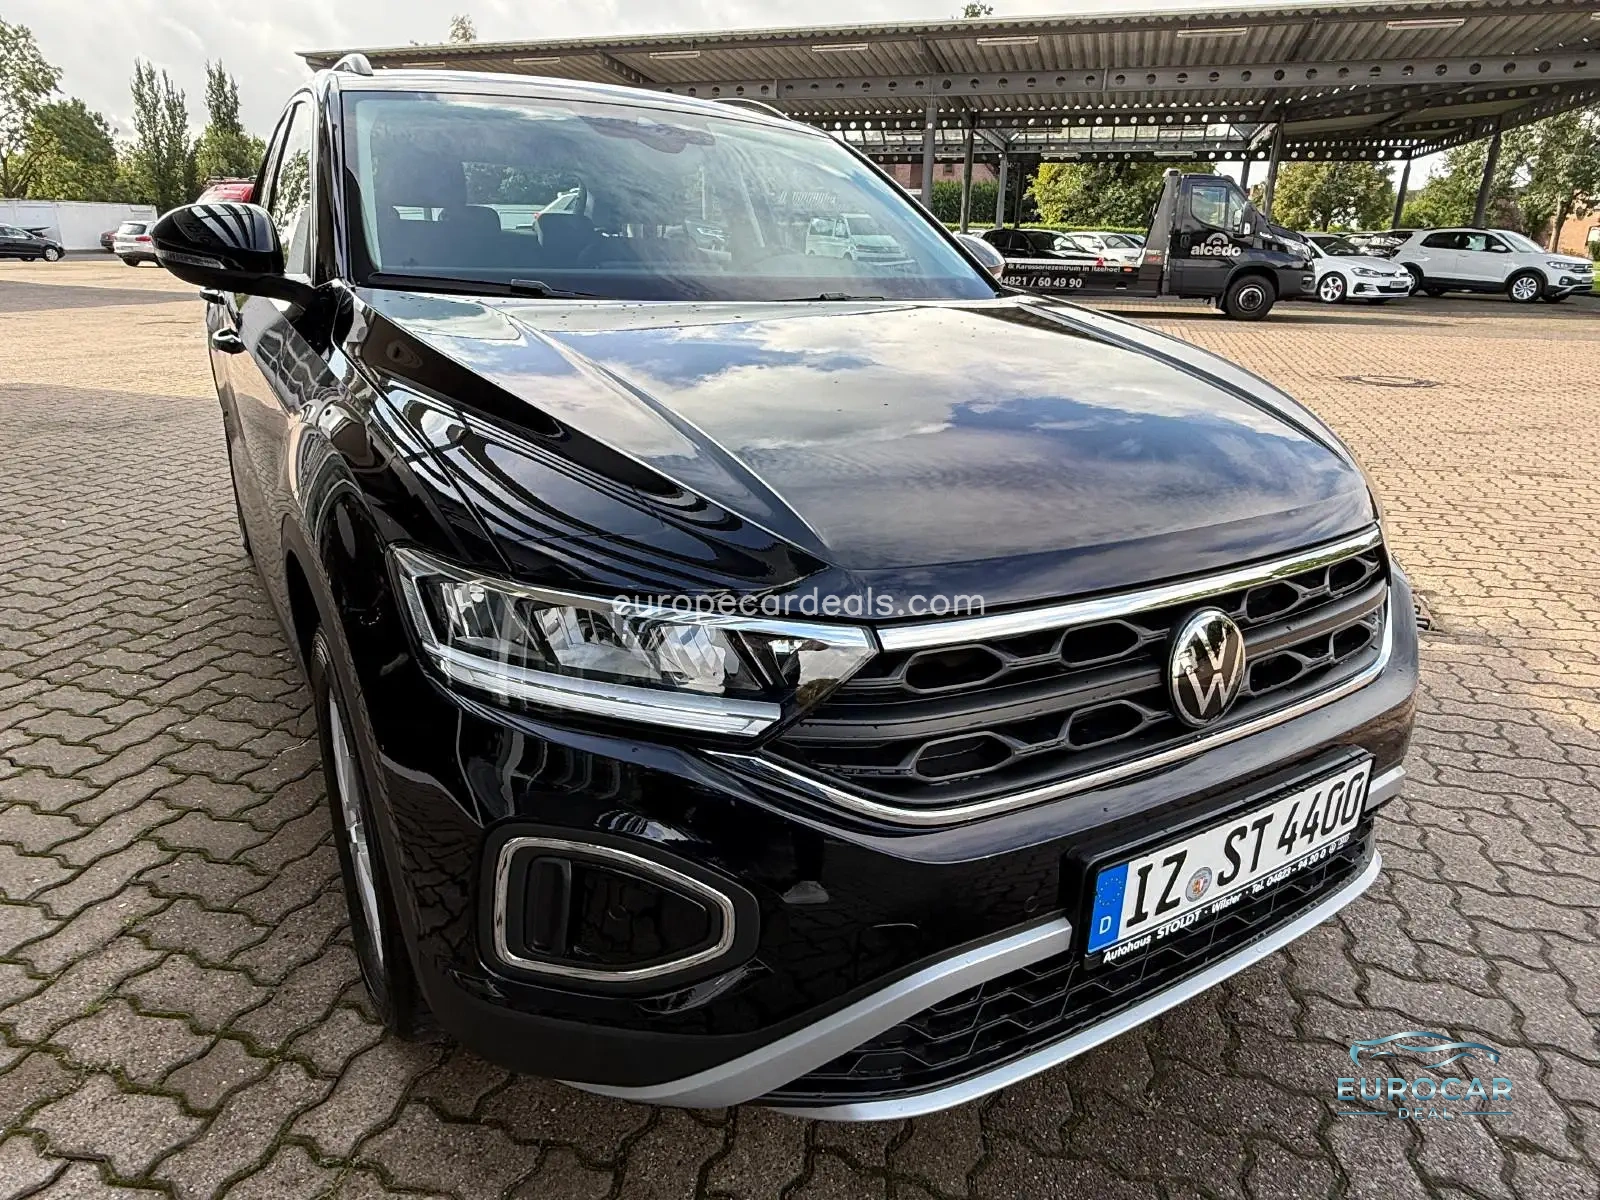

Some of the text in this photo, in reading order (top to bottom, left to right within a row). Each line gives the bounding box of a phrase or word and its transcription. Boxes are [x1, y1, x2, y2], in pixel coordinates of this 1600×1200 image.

[1190, 242, 1242, 257] alcedo
[1038, 277, 1051, 287] 60
[1053, 278, 1067, 287] 49
[1069, 278, 1082, 288] 90
[1127, 771, 1364, 928] IZ ST 4400
[1099, 915, 1112, 935] D
[1103, 935, 1151, 964] Autohaus
[1156, 911, 1201, 940] STOLDT
[1211, 893, 1242, 914] Wilster
